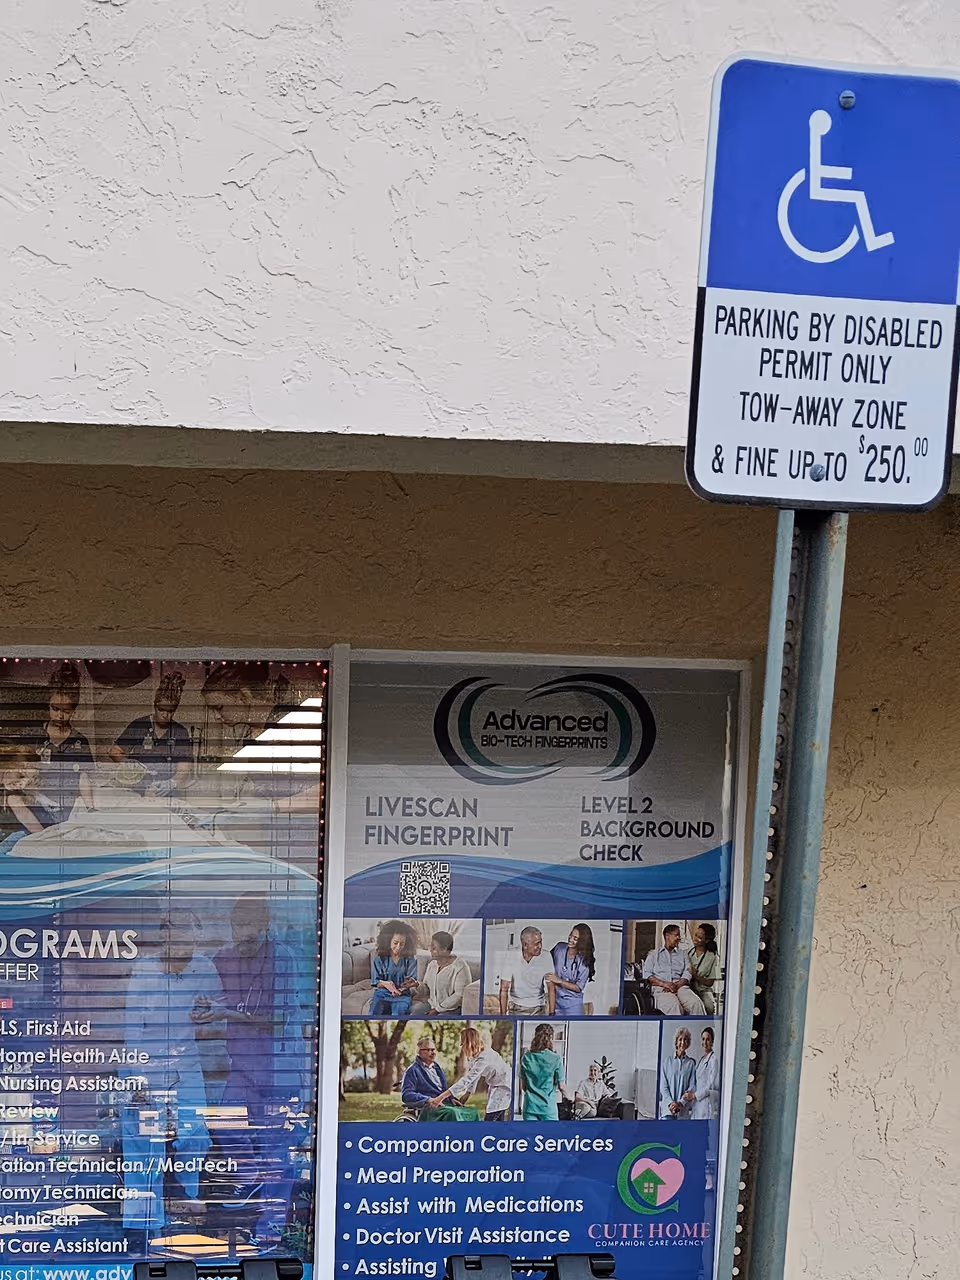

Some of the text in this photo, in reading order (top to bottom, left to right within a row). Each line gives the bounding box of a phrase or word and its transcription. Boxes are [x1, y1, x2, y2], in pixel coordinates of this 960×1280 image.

[715, 305, 943, 349] PARKING BY DISABLED
[759, 348, 892, 384] PERMIT ONLY
[740, 391, 908, 430] TOW-AWAY ZONE
[711, 444, 848, 482] & FINE UP TO
[483, 709, 609, 733] Advanced
[480, 735, 608, 750] BIO-TECH FINGERPRINTS
[366, 796, 478, 819] LIVESCAN
[582, 796, 653, 814] LEVEL 2
[365, 825, 514, 848] FINGERPRINT
[580, 820, 715, 840] BACKGROUND
[579, 844, 643, 862] CHECK
[26, 1020, 59, 1036] First
[61, 1020, 91, 1036] Aid
[49, 1047, 106, 1064] Health
[108, 1048, 150, 1064] Aide
[65, 1075, 143, 1092] Assistant
[11, 1130, 100, 1149] In-Service
[358, 1135, 614, 1155] Companion Care Services
[48, 1157, 144, 1173] Technician
[157, 1157, 238, 1173] MedTech
[357, 1166, 525, 1186] Meal Preparation
[43, 1184, 139, 1200] Technician
[356, 1196, 584, 1215] Assist with Medications
[356, 1226, 570, 1245] Doctor Visit Assistance
[588, 1222, 712, 1239] CUTE HOME
[7, 1238, 51, 1254] Care
[53, 1237, 129, 1253] Assistant
[595, 1240, 645, 1248] COMPANION
[672, 1239, 705, 1247] AGENCY
[355, 1257, 437, 1278] Assisting
